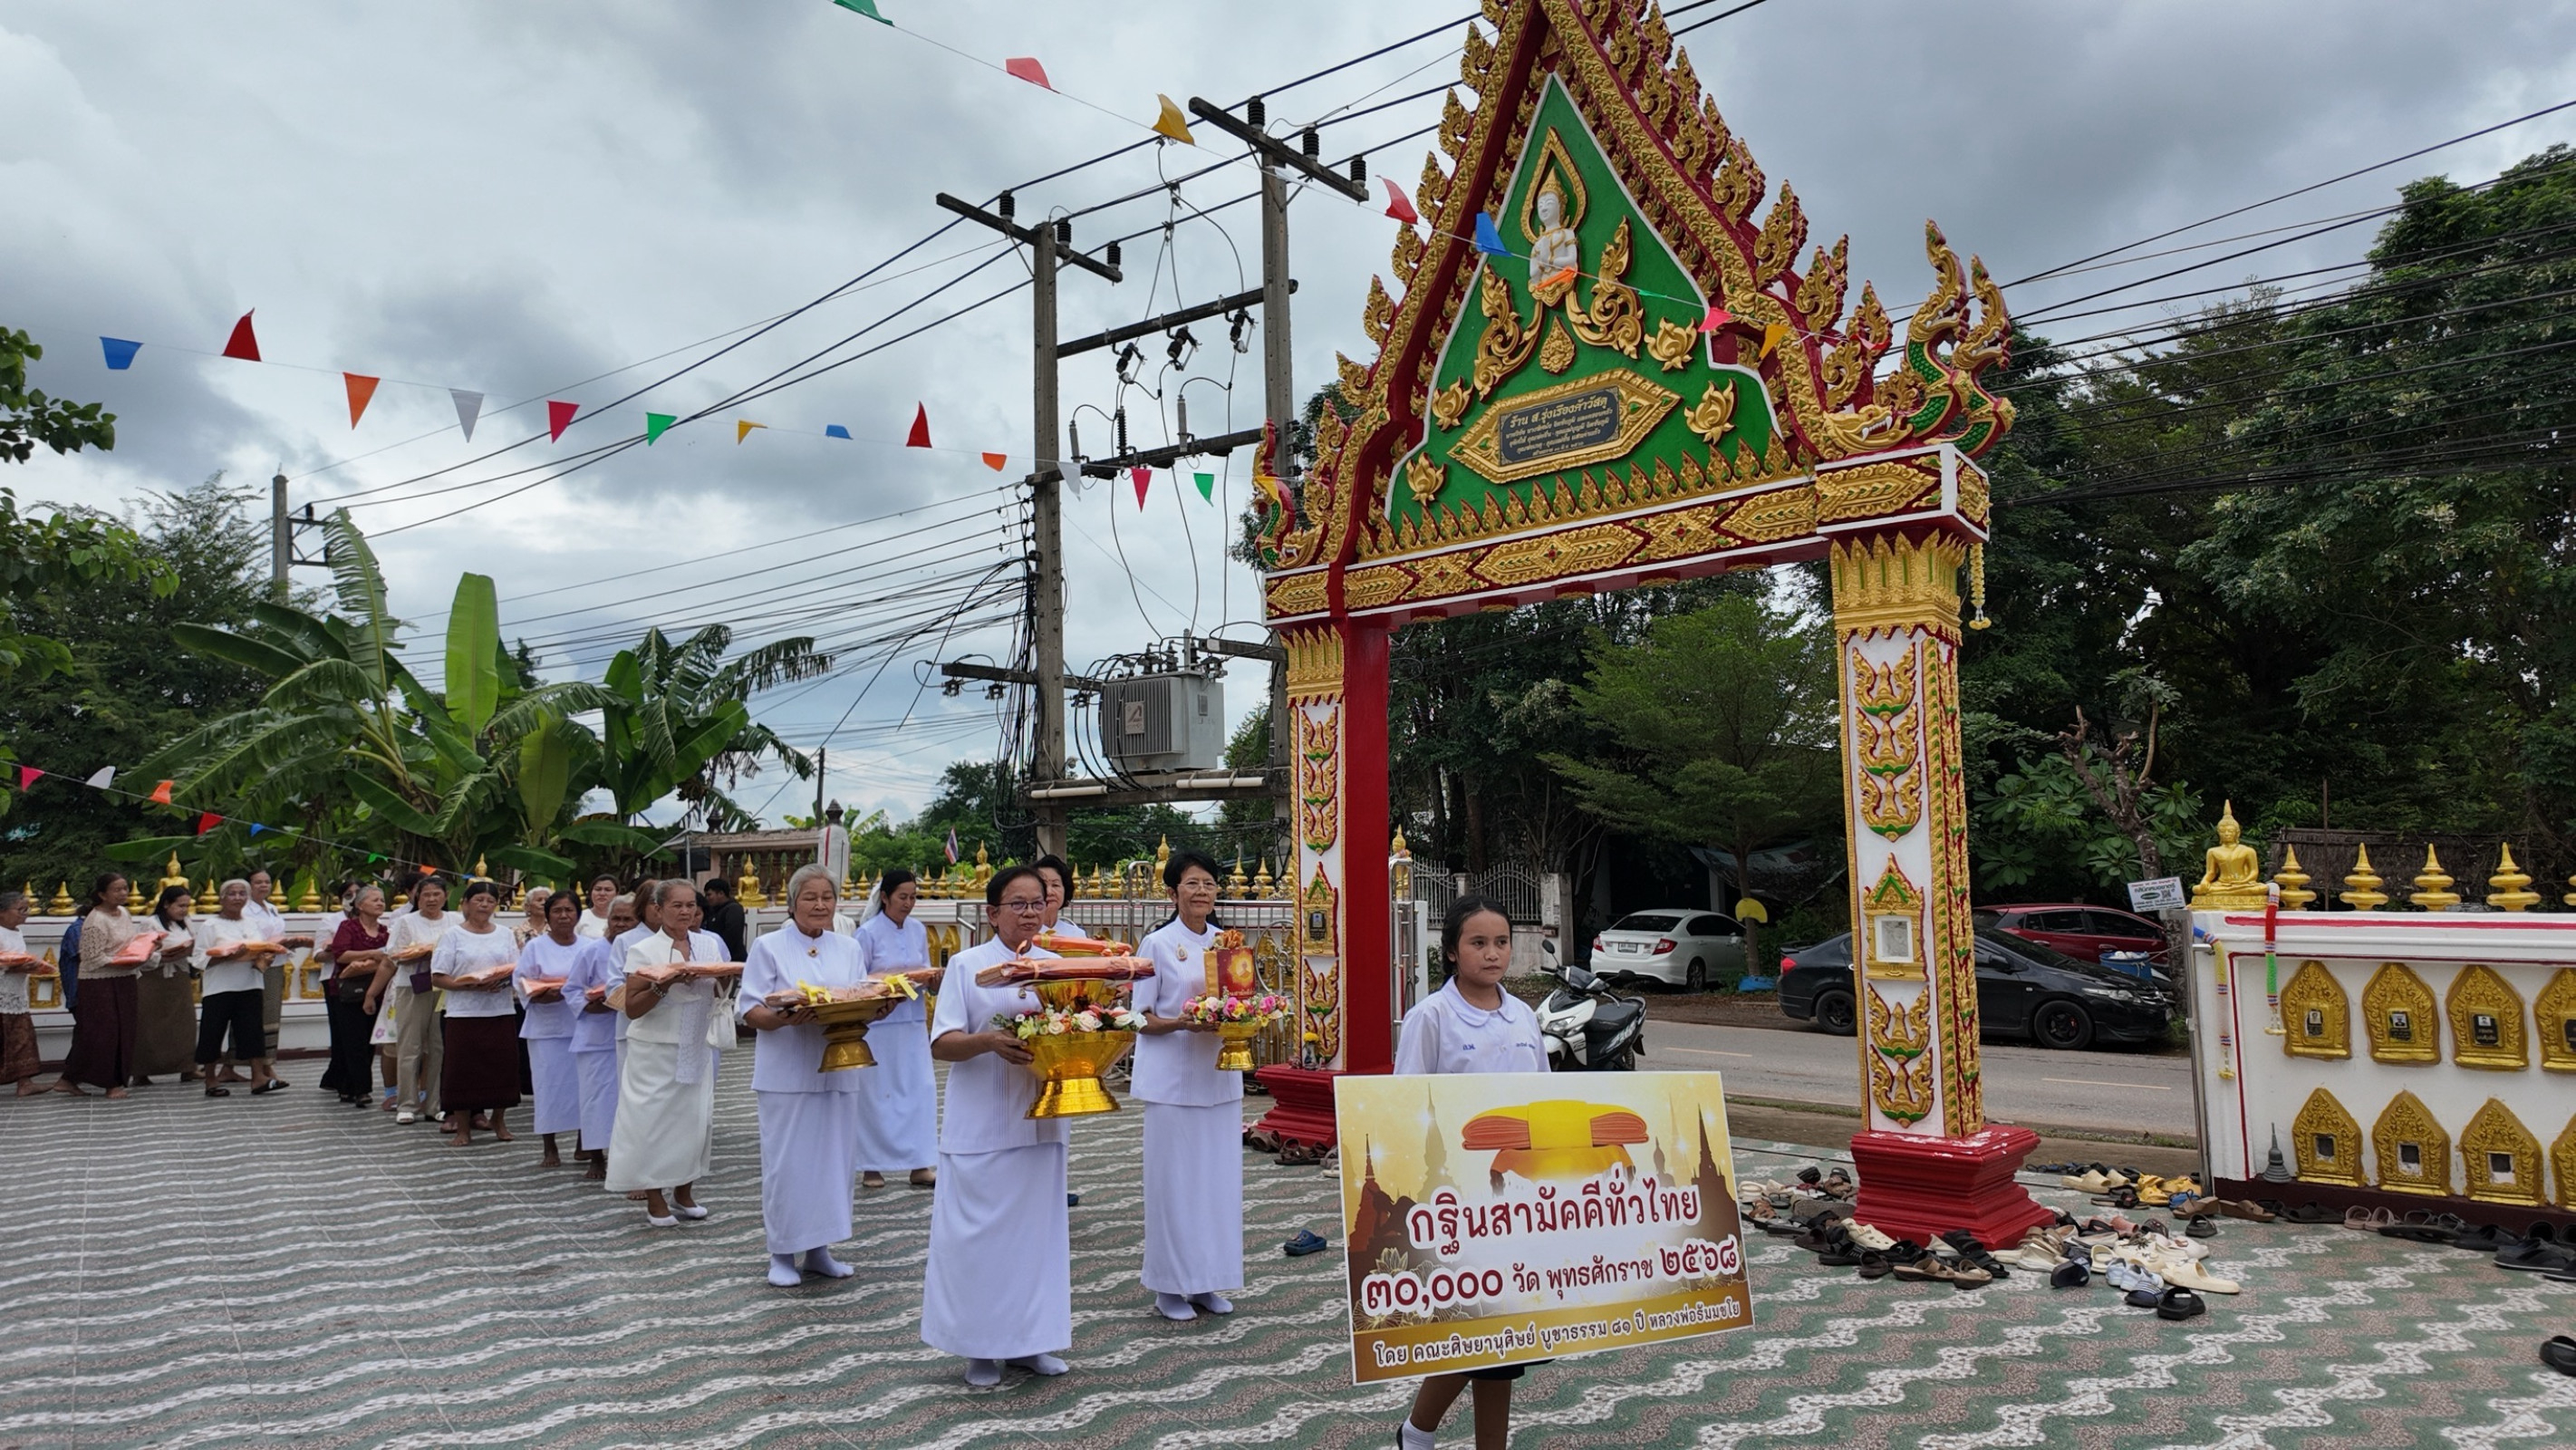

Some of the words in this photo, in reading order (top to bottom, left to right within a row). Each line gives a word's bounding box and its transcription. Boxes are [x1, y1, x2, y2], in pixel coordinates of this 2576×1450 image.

[1510, 415, 1529, 428] ร้าน
[1411, 1168, 1698, 1256] กฐินสามัคคีทั่วไทย
[1366, 1269, 1503, 1310] ๓๐,๐๐๐
[1512, 1262, 1540, 1293] วัด
[1546, 1255, 1655, 1300] พุทธศักราช
[1659, 1240, 1738, 1276] ๒๕๖๘
[1375, 1343, 1407, 1365] โดย
[1413, 1324, 1536, 1360] คณะศิษยานุศิษย์
[1540, 1323, 1607, 1349] บูชาธรรม
[1611, 1320, 1631, 1334] ๘๑
[1635, 1310, 1645, 1330] ปี
